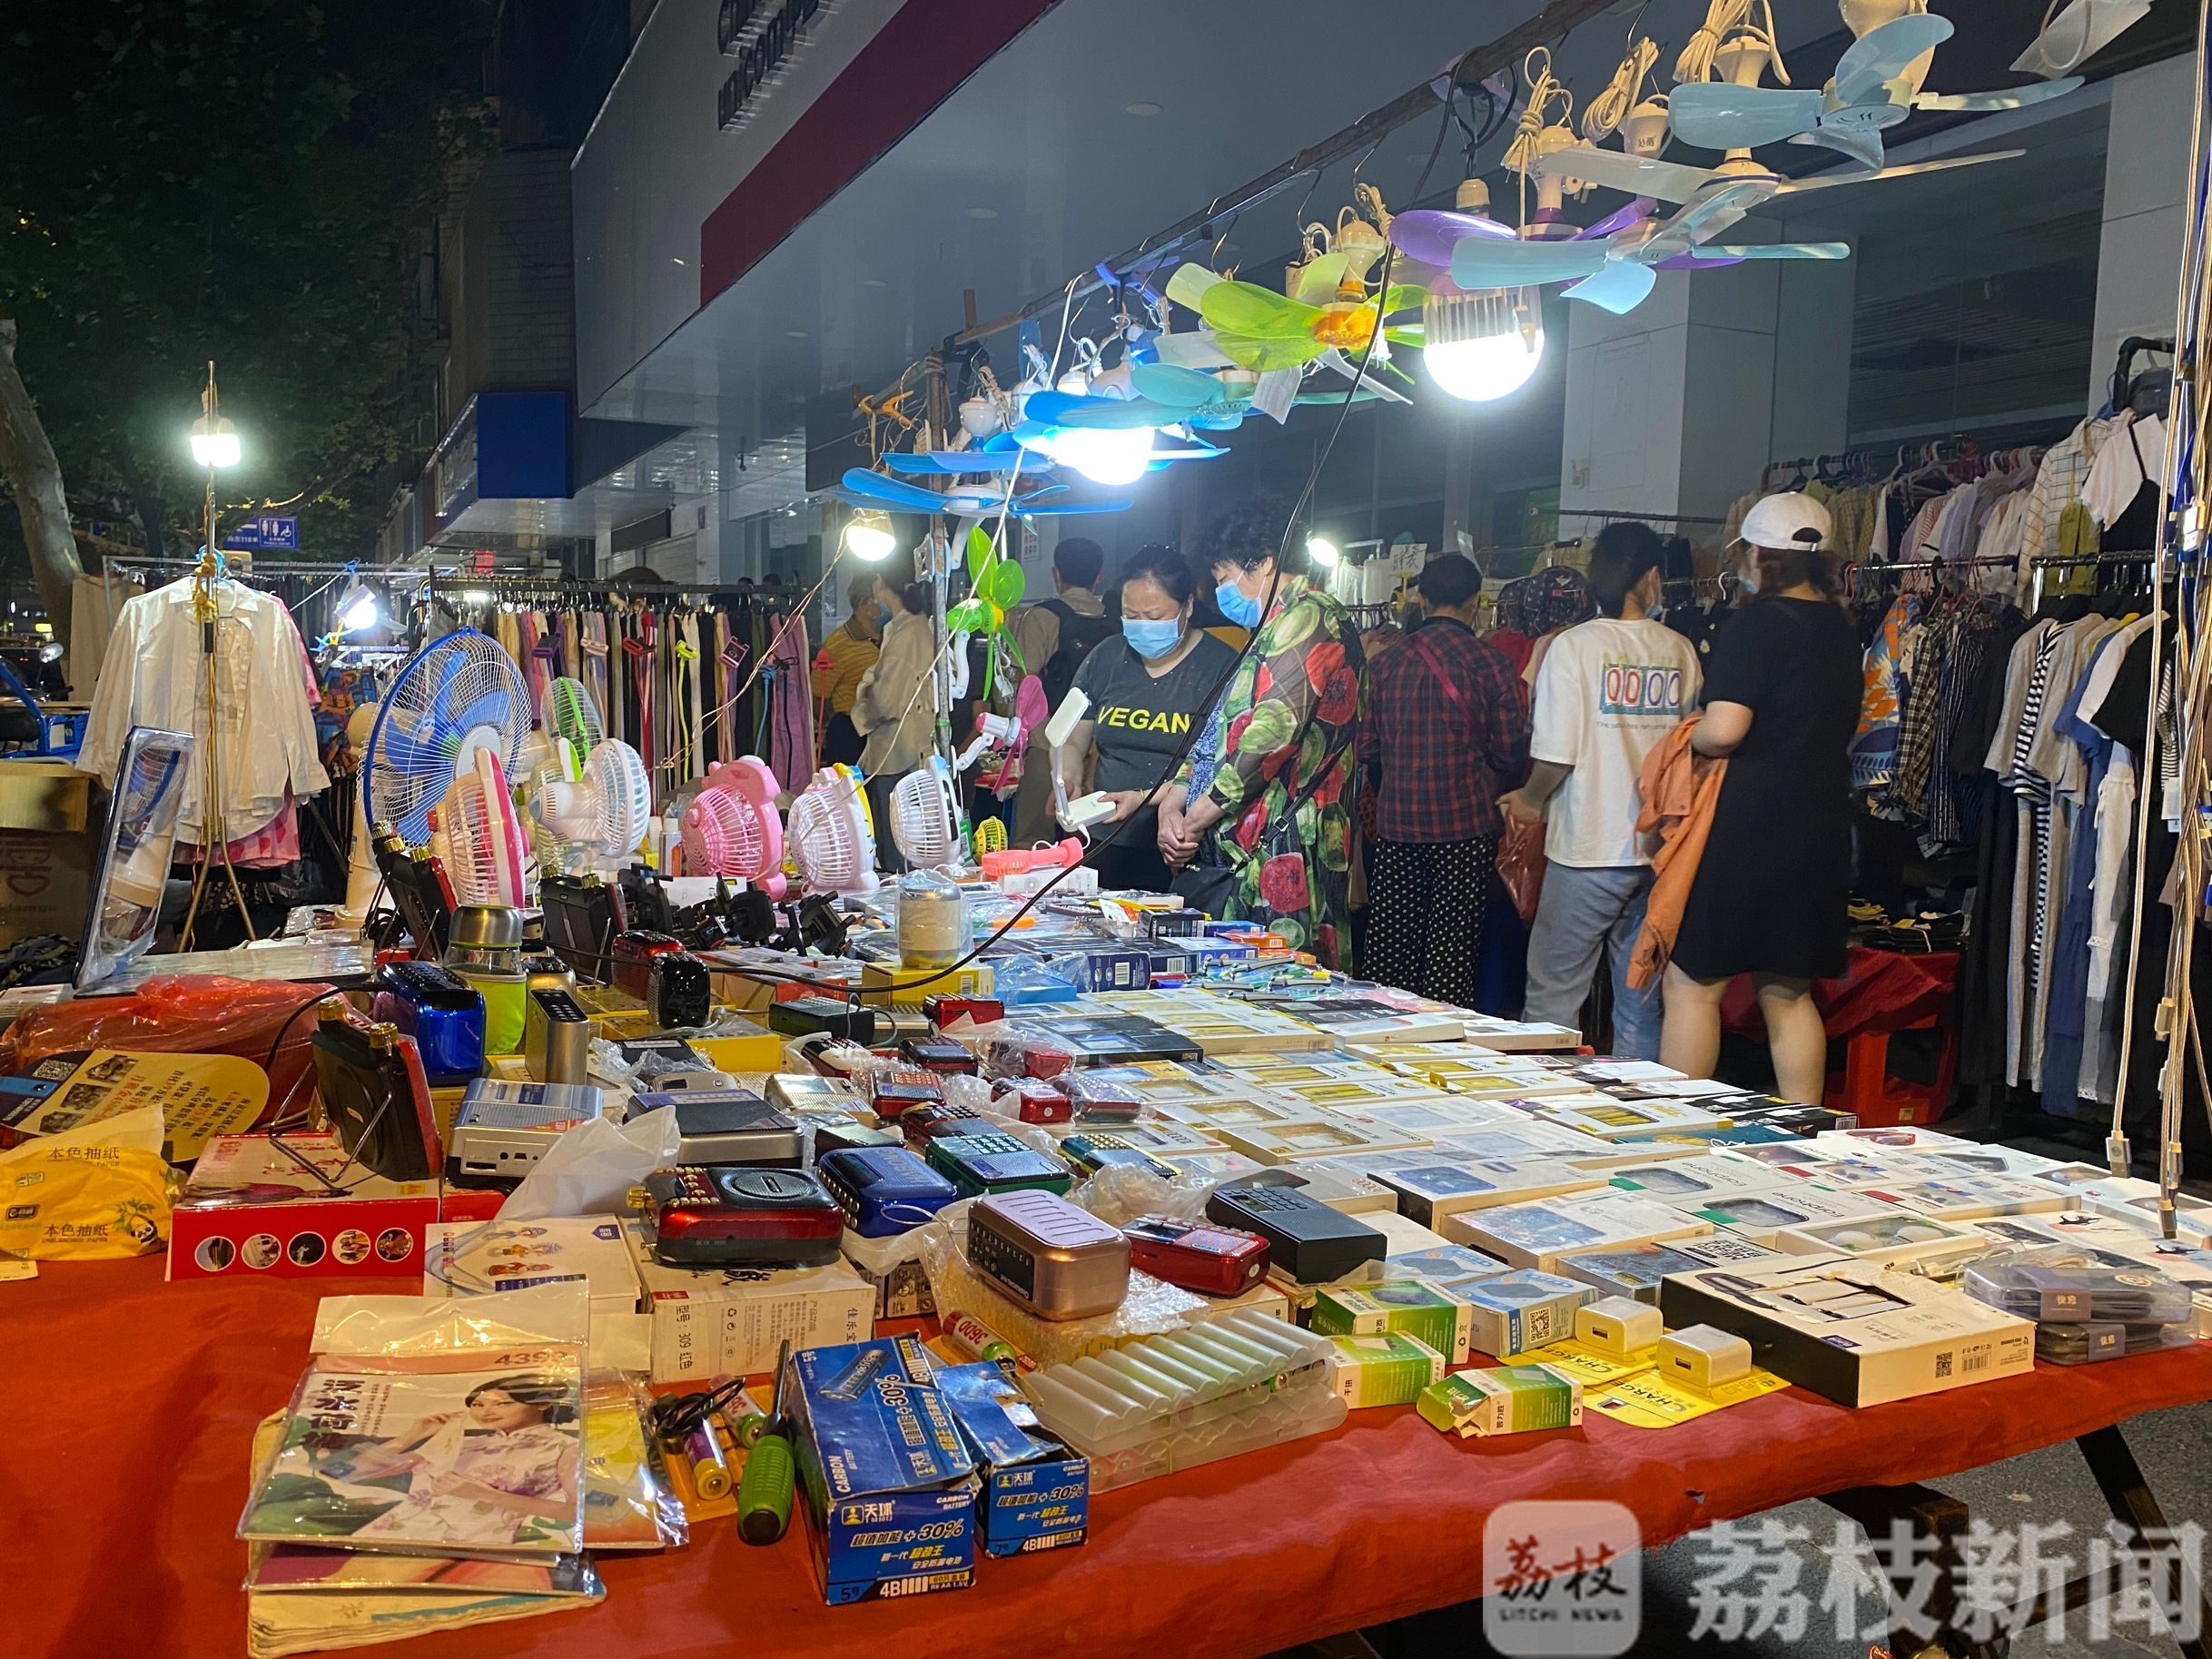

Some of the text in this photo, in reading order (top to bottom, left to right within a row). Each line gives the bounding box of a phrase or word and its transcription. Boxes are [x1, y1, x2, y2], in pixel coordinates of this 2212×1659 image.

[1097, 706, 1190, 734] VEGAN
[49, 1147, 120, 1160] 本色抽纸
[1681, 1160, 1748, 1188] Earphone
[1772, 1190, 1845, 1219] Earphone
[45, 1223, 109, 1237] 本色抽纸
[678, 1332, 692, 1348] 309
[959, 1320, 988, 1345] 3600
[679, 1352, 694, 1370] 红色
[1541, 1348, 1613, 1374] CHARGE
[1611, 1380, 1687, 1413] CHARGE
[827, 1455, 852, 1494] CARBON
[864, 1502, 893, 1517] 天球
[936, 1495, 969, 1504] CARBON
[943, 1500, 971, 1510] BATTERY
